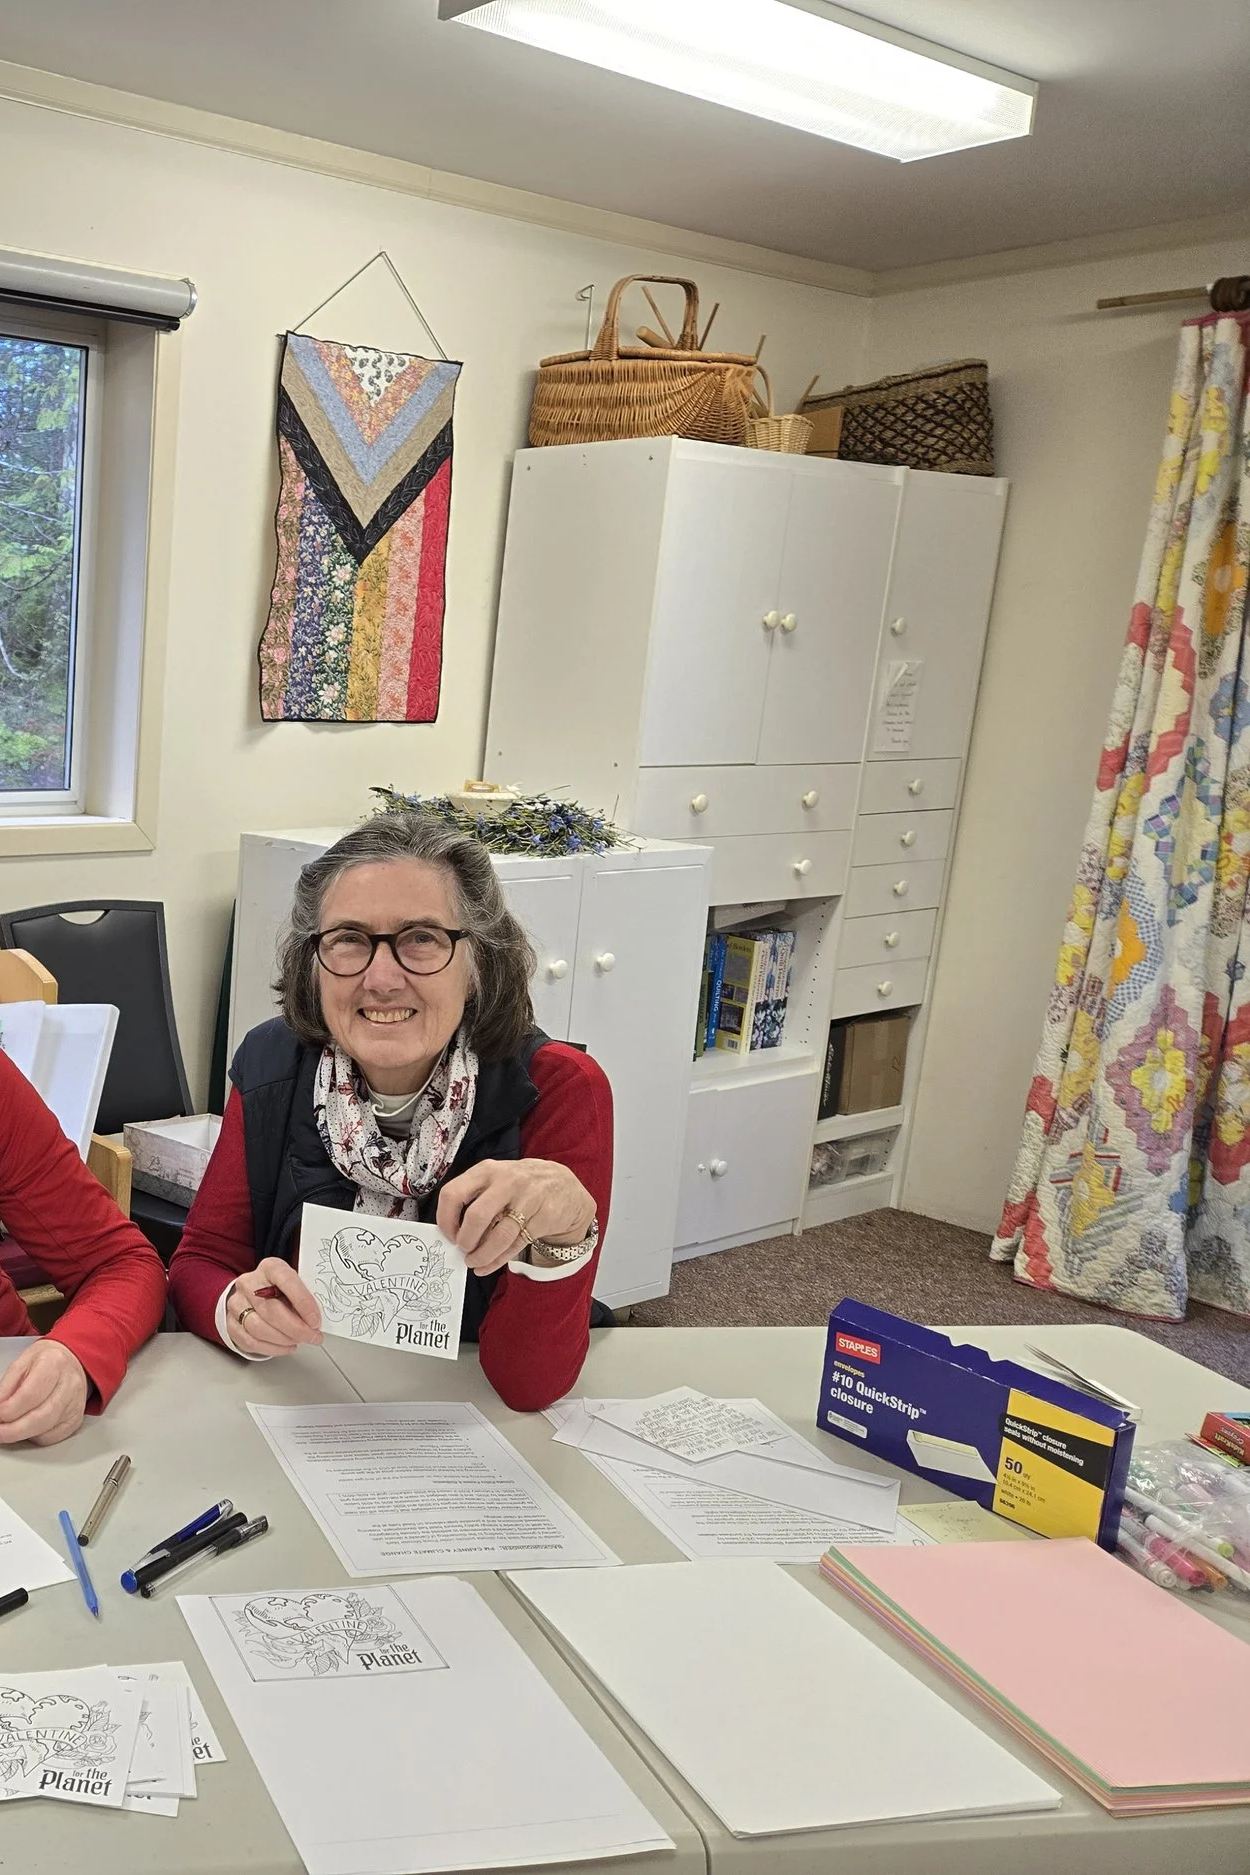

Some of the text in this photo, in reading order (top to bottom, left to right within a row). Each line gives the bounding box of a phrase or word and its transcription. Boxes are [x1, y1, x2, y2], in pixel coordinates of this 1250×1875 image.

[713, 979, 723, 1012] QUILTING
[353, 1276, 427, 1296] VALENTINE
[419, 1319, 446, 1332] for the
[396, 1322, 450, 1350] Planet
[838, 1338, 878, 1358] STAPLES
[834, 1360, 865, 1378] envelopes
[832, 1371, 853, 1389] #10
[830, 1388, 874, 1414] closure
[1004, 1426, 1084, 1466] seals without moistening
[1042, 1434, 1067, 1449] closure
[1005, 1457, 1022, 1474] 50
[293, 1620, 364, 1643] VALENTINE
[390, 1643, 409, 1653] the
[357, 1649, 422, 1670] Planet
[38, 1768, 113, 1796] Planet
[85, 1767, 108, 1780] the
